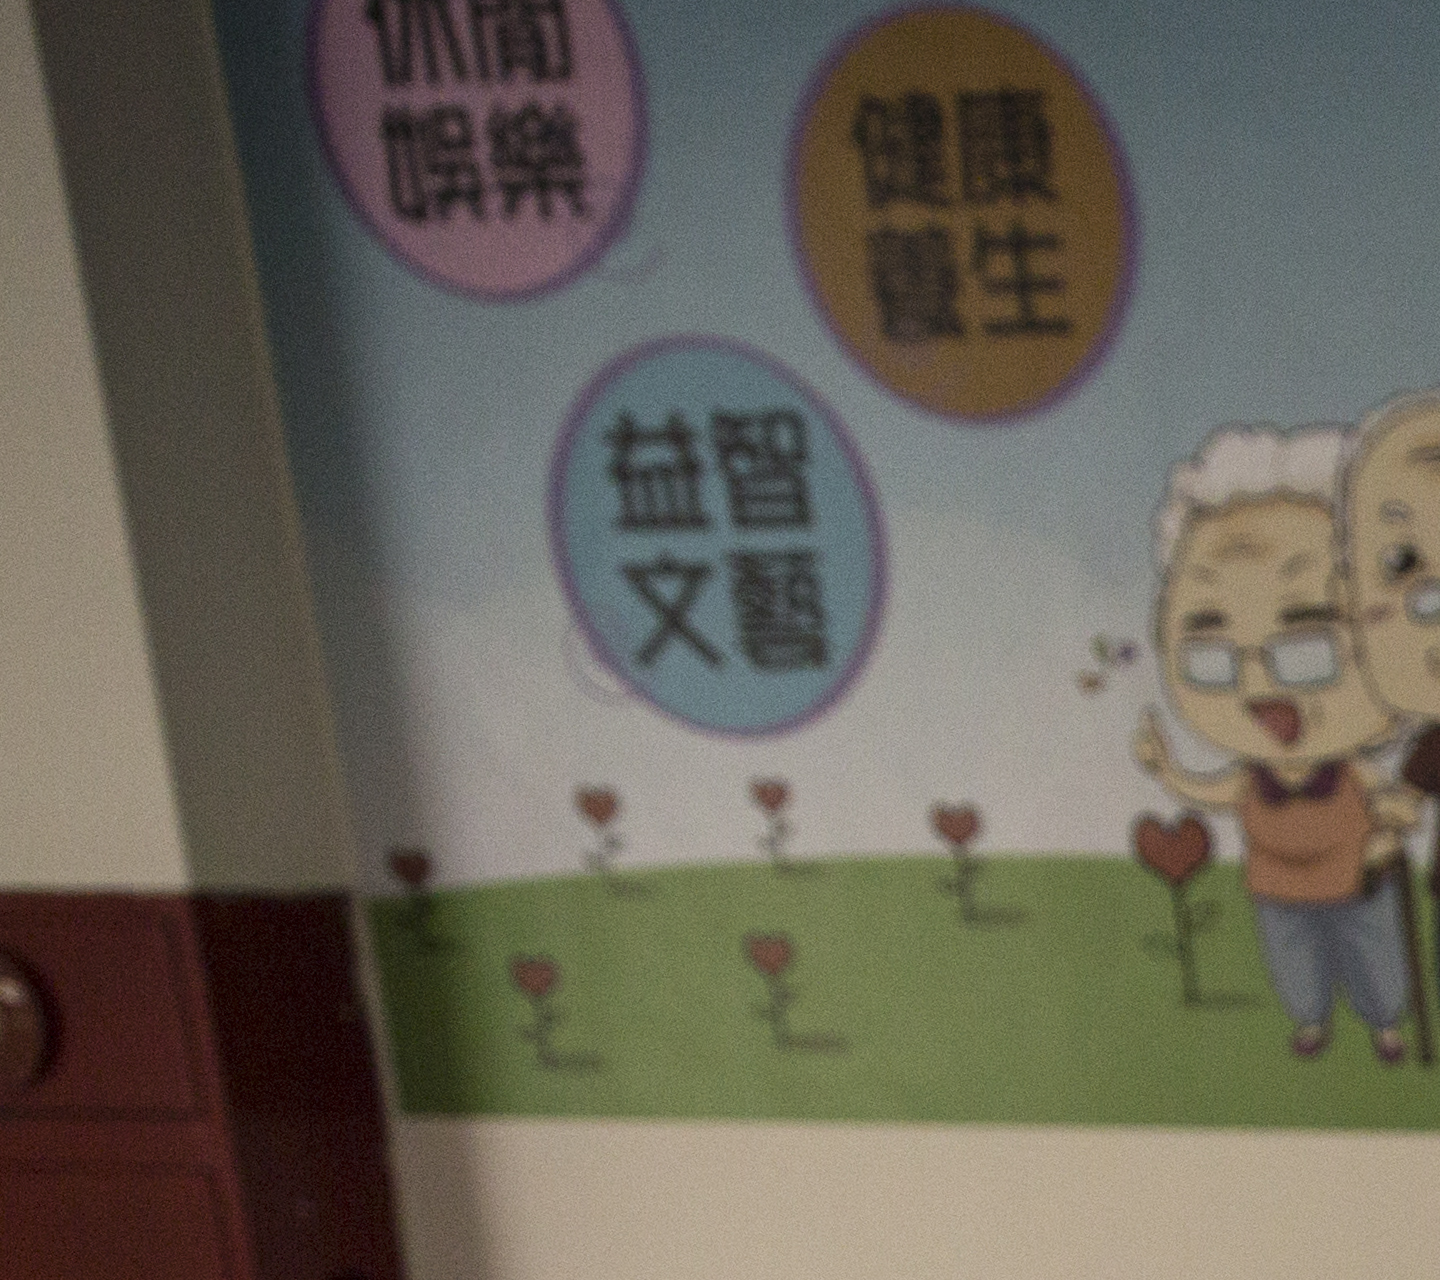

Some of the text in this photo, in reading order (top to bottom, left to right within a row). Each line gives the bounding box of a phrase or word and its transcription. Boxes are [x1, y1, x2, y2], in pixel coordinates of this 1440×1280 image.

[378, 100, 588, 224] 娛樂
[850, 86, 1058, 208] 健康
[865, 219, 1073, 343] 養生
[605, 408, 813, 533] 益智
[620, 547, 829, 671] 文藝
